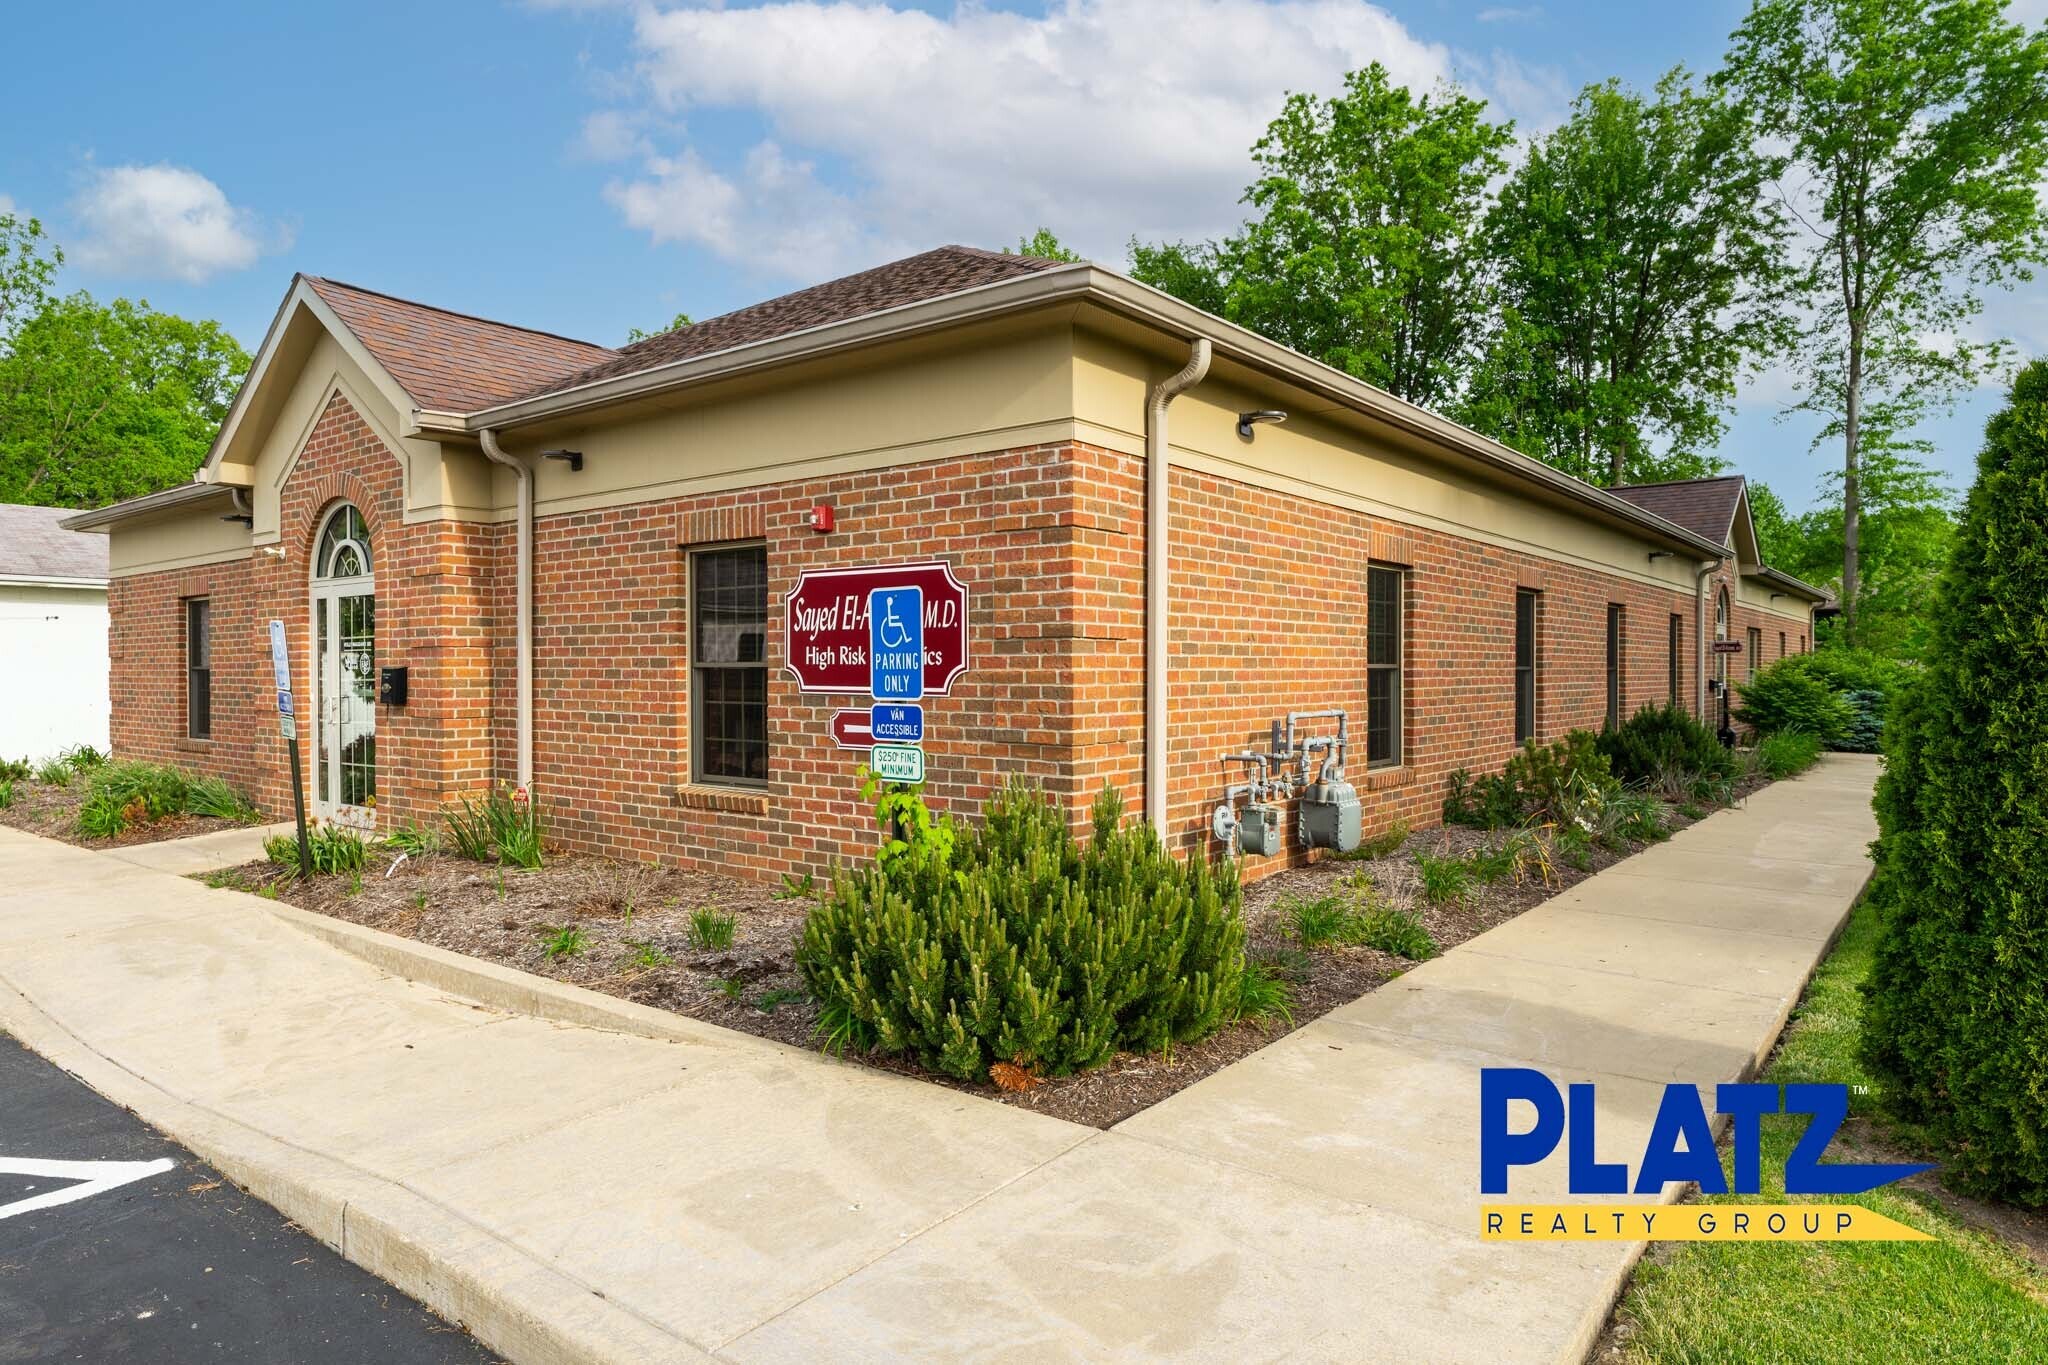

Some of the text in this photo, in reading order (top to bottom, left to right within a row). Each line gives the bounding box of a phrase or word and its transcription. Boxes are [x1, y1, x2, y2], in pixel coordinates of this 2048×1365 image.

[794, 596, 839, 641] Sayed
[924, 600, 957, 628] M.D.
[805, 645, 866, 670] High Risk
[875, 652, 918, 670] PARKING
[884, 674, 910, 692] ONLY
[890, 709, 905, 721] VAN
[876, 723, 919, 737] ACCESSIBLE
[900, 752, 917, 764] FINE
[881, 763, 914, 777] MINIMUM
